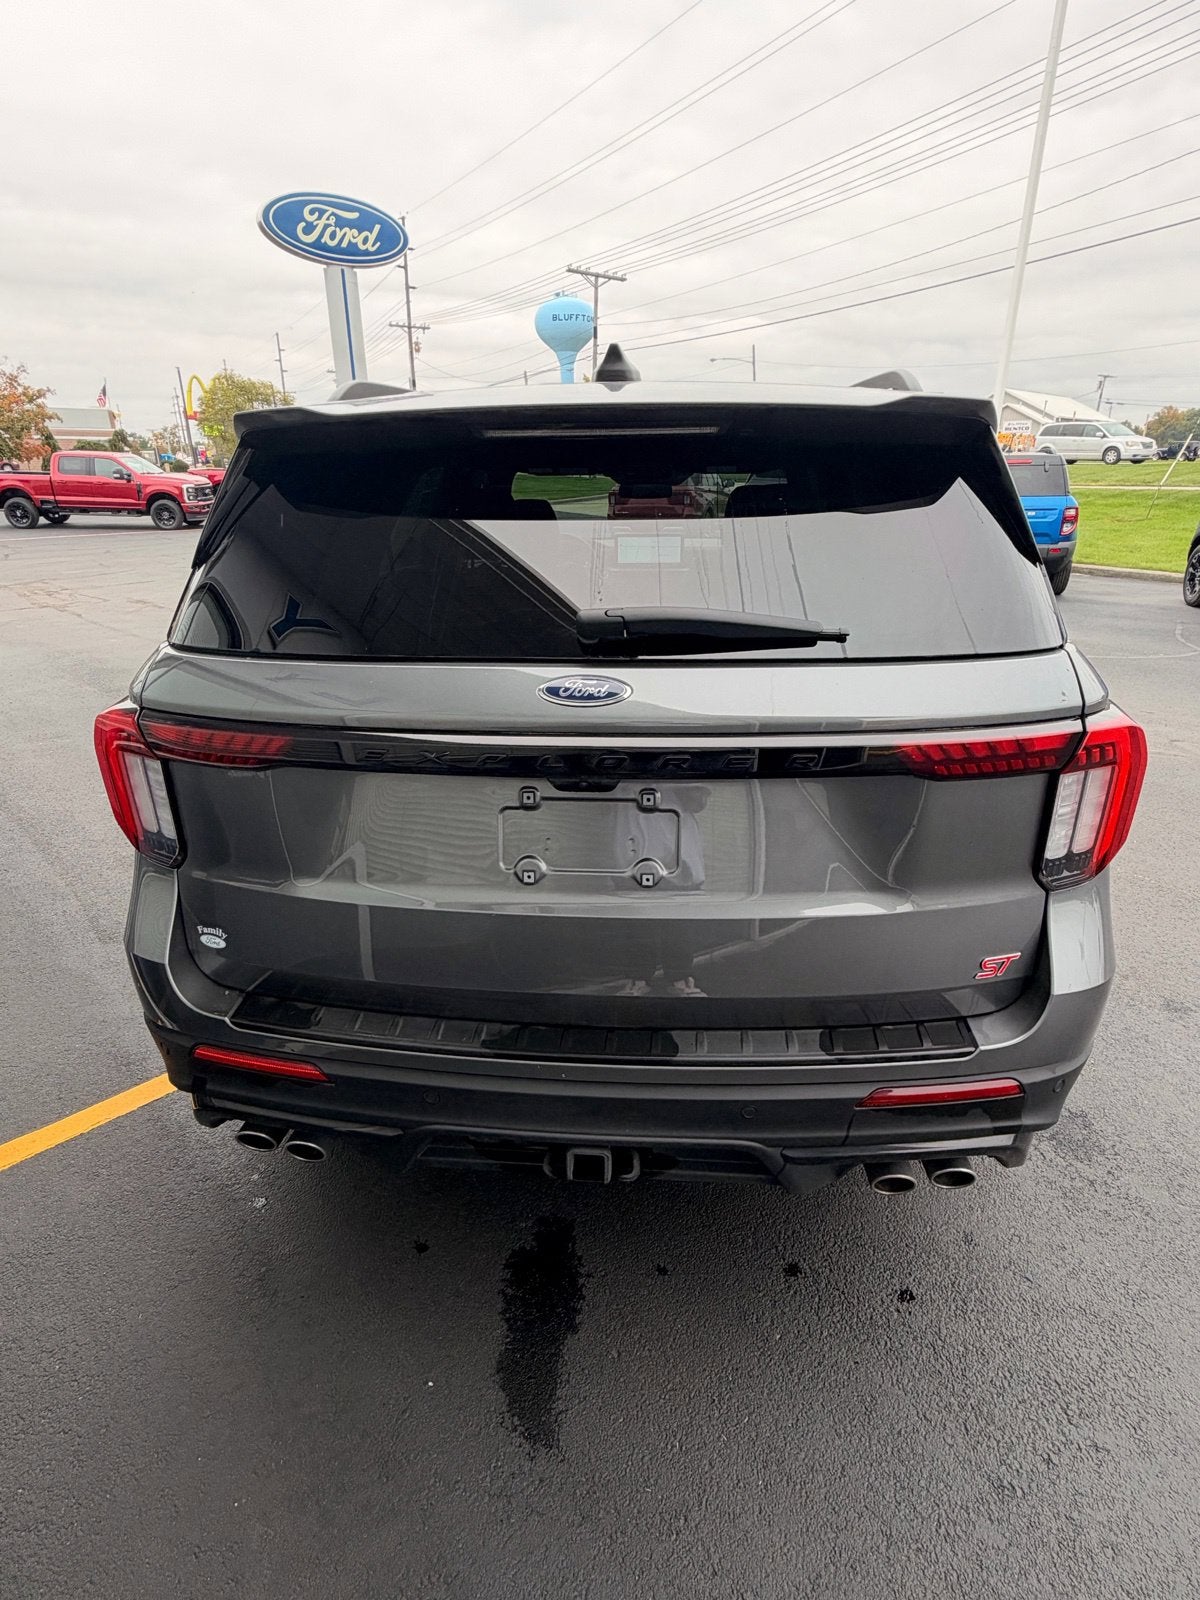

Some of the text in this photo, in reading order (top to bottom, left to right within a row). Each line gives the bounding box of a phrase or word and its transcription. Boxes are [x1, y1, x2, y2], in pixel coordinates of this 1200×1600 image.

[296, 203, 382, 252] Ford
[558, 679, 610, 697] Ford
[362, 749, 820, 770] EXPLORER
[197, 925, 228, 940] Family
[205, 935, 222, 947] Ford
[974, 952, 1022, 979] ST
